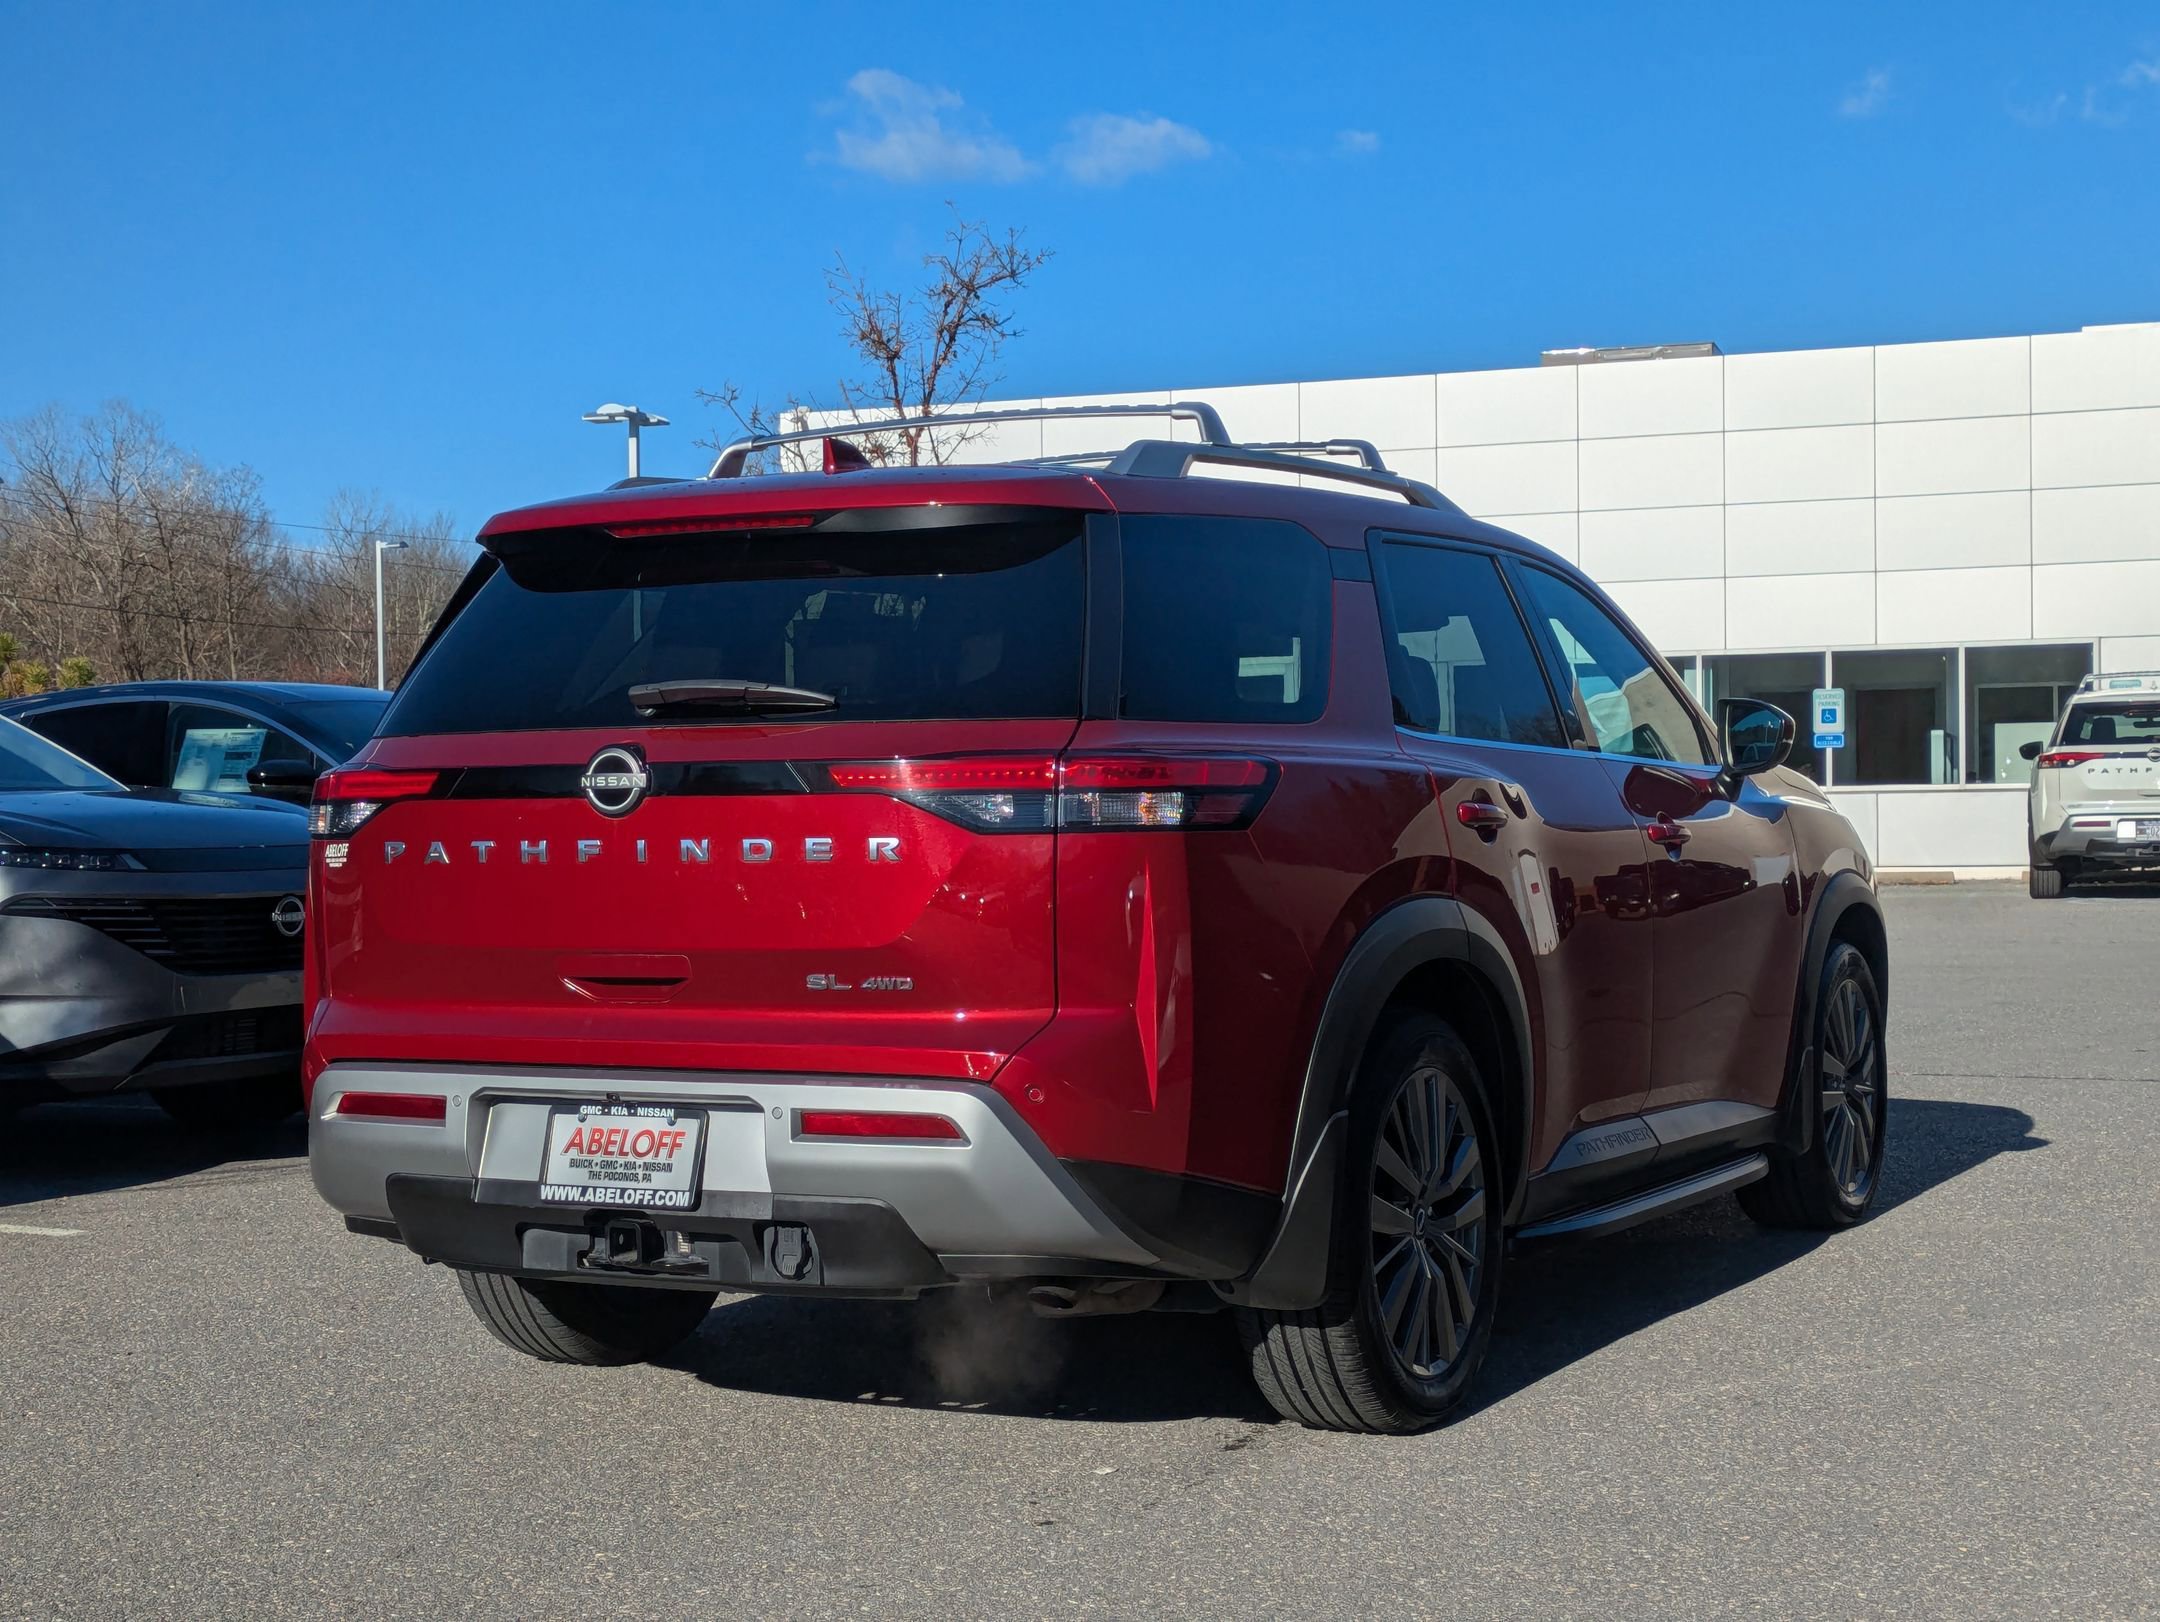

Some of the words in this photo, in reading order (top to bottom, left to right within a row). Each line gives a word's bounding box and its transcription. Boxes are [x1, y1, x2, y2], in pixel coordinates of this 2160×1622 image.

[581, 776, 644, 787] NISSAN
[325, 843, 349, 857] ABELOFF
[384, 837, 902, 863] PATHFINDER
[806, 974, 852, 990] SL
[861, 976, 913, 990] 4WD
[580, 1105, 602, 1115] GMC
[611, 1106, 628, 1116] KIA
[637, 1107, 674, 1118] NISSAN
[560, 1127, 686, 1160] ABELOFF
[1576, 1127, 1653, 1157] PATHFINDER
[569, 1158, 594, 1169] BUICK
[600, 1160, 618, 1170] GMC
[624, 1161, 637, 1171] KIA
[642, 1162, 673, 1173] NISSAN
[588, 1171, 602, 1180] THE
[603, 1171, 641, 1184] POCONOS,
[641, 1173, 652, 1183] PA
[540, 1185, 690, 1207] WWW.ABELOFF.COM
